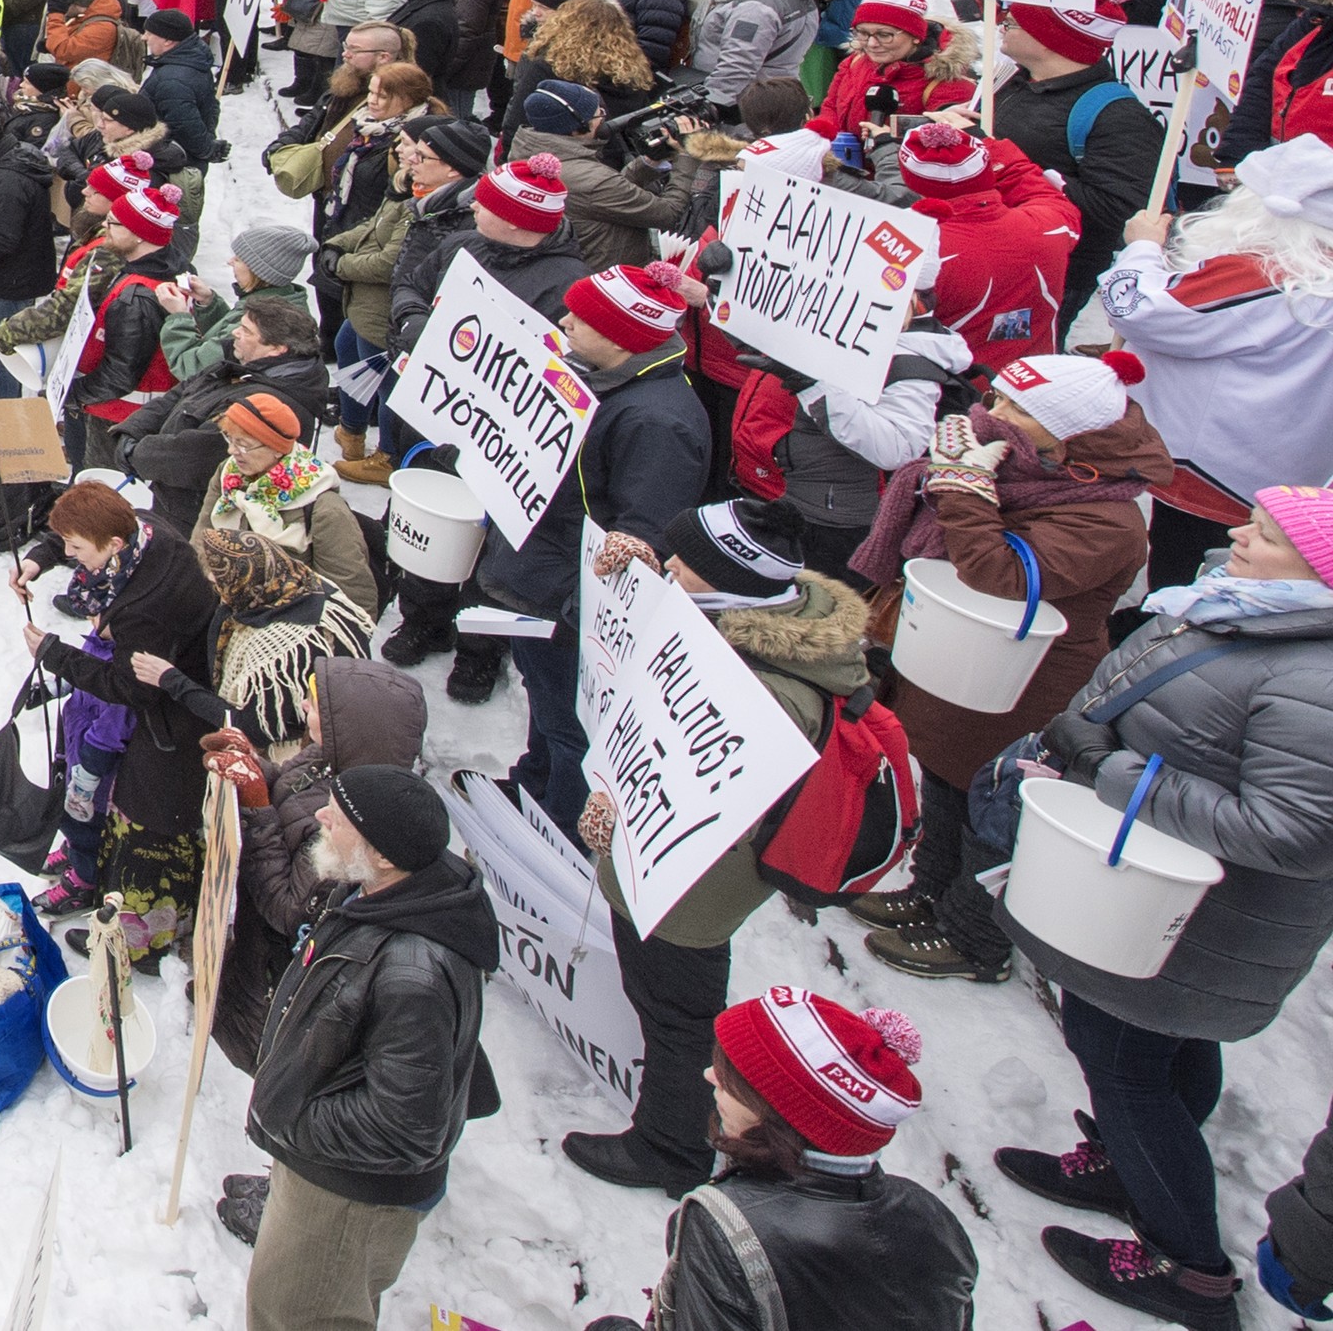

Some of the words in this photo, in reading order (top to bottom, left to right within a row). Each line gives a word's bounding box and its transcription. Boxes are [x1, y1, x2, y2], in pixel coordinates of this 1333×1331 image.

[521, 190, 542, 202] PAM
[768, 178, 865, 277] ÄÄNI
[874, 228, 910, 263] PAM
[636, 303, 661, 317] PAM
[734, 244, 893, 355] TYÖTTÖMÄLLE
[1006, 362, 1036, 384] PAM
[449, 315, 575, 474] OIKEUTTA
[724, 534, 755, 560] PAM
[828, 1067, 869, 1099] PAM
